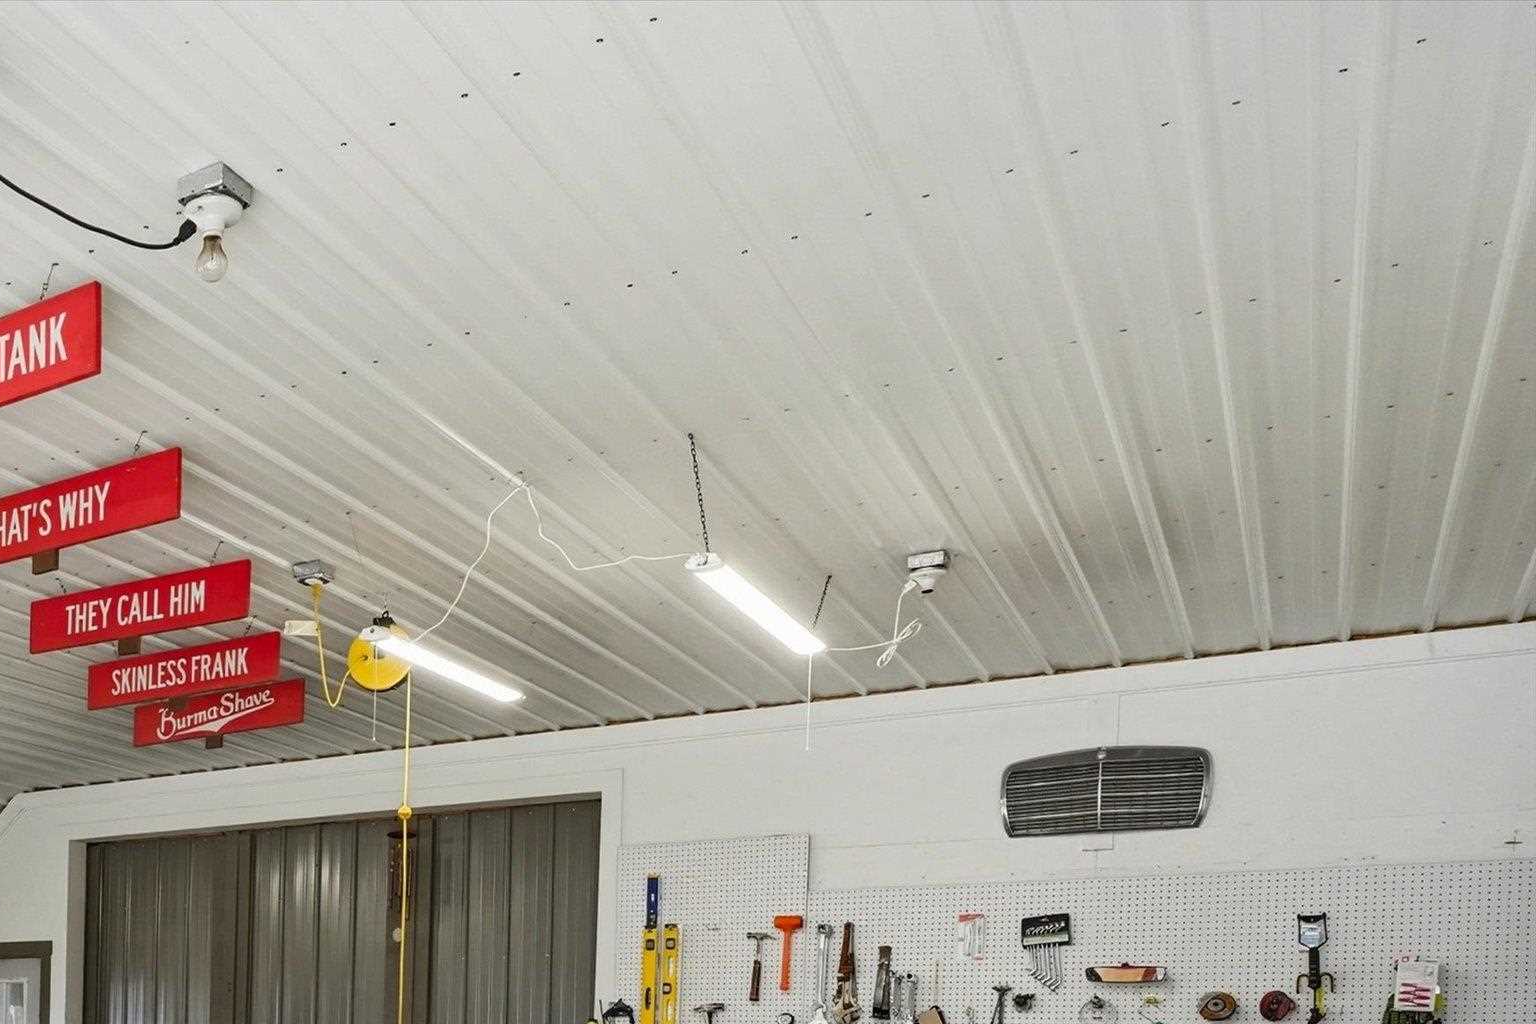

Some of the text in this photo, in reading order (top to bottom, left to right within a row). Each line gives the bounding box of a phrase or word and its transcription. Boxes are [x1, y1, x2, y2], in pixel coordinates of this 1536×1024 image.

[58, 481, 112, 532] WHY
[66, 579, 206, 635] THEY CALL HIM
[111, 647, 249, 696] SKINLESS FRANK
